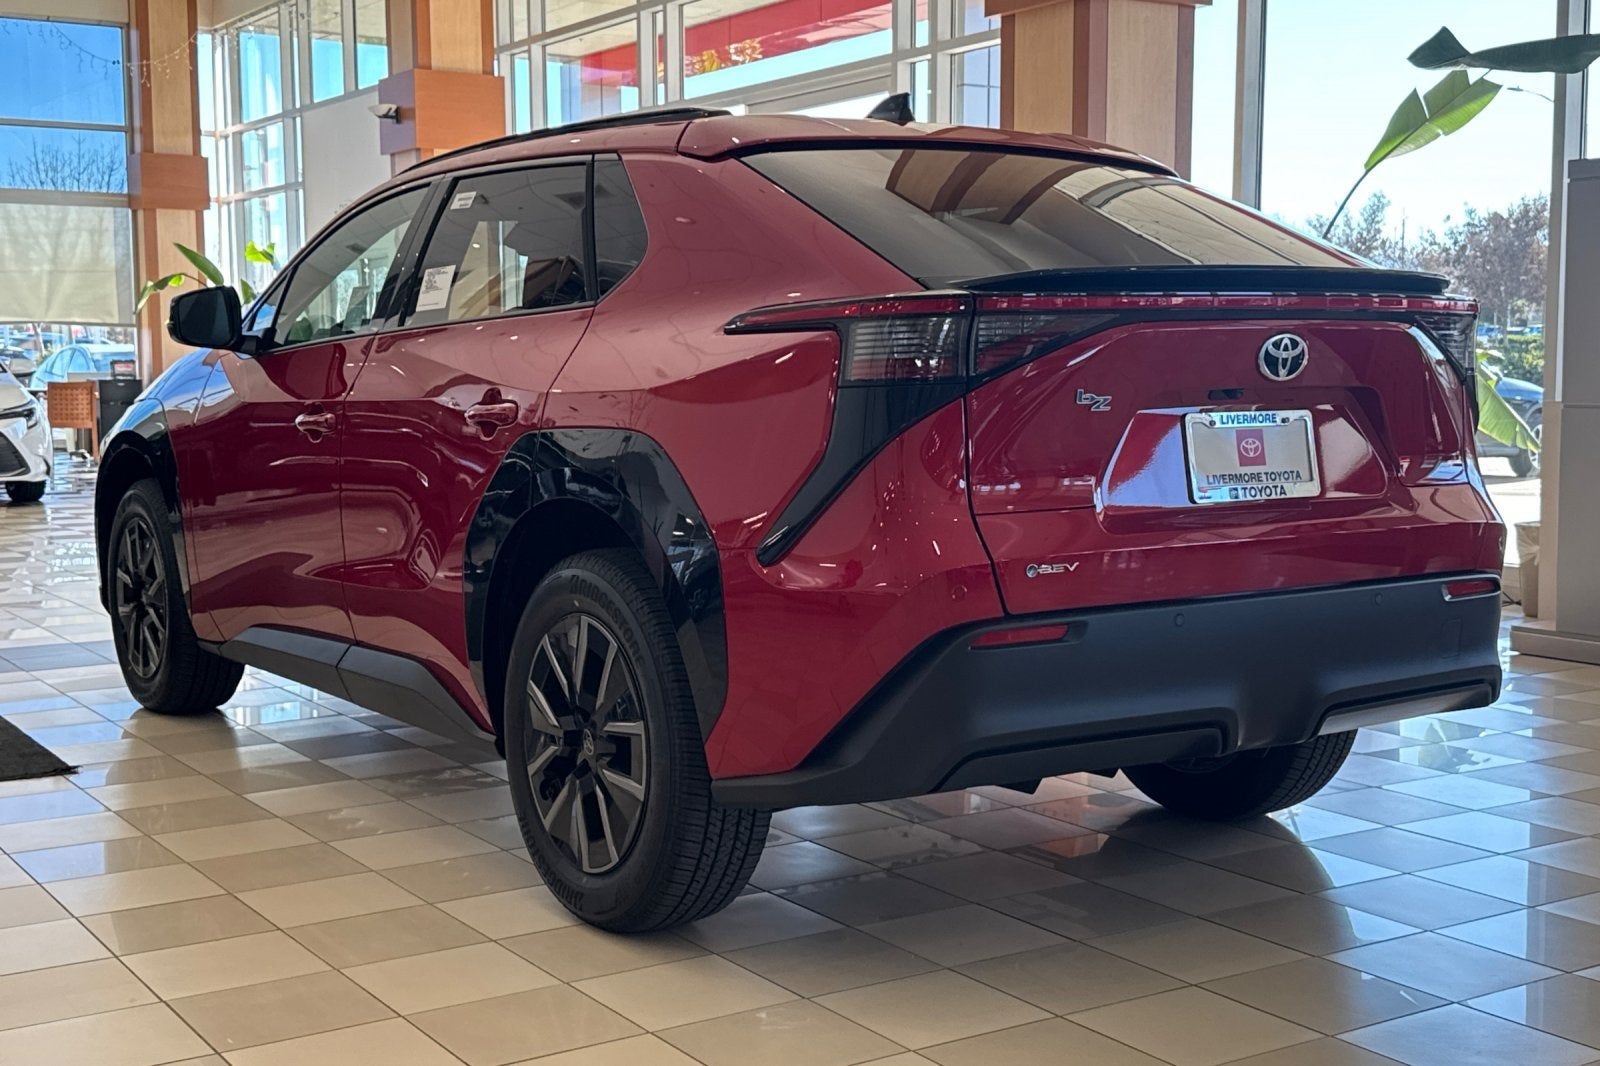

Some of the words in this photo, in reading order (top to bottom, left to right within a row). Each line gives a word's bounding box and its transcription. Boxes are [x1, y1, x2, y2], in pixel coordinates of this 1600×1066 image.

[1220, 413, 1277, 425] LIVERMORE
[1206, 473, 1263, 485] LIVERMORE
[1264, 470, 1302, 481] TOYOTA
[1241, 485, 1287, 498] TOYOTA
[569, 575, 645, 665] BRIDGESTONE
